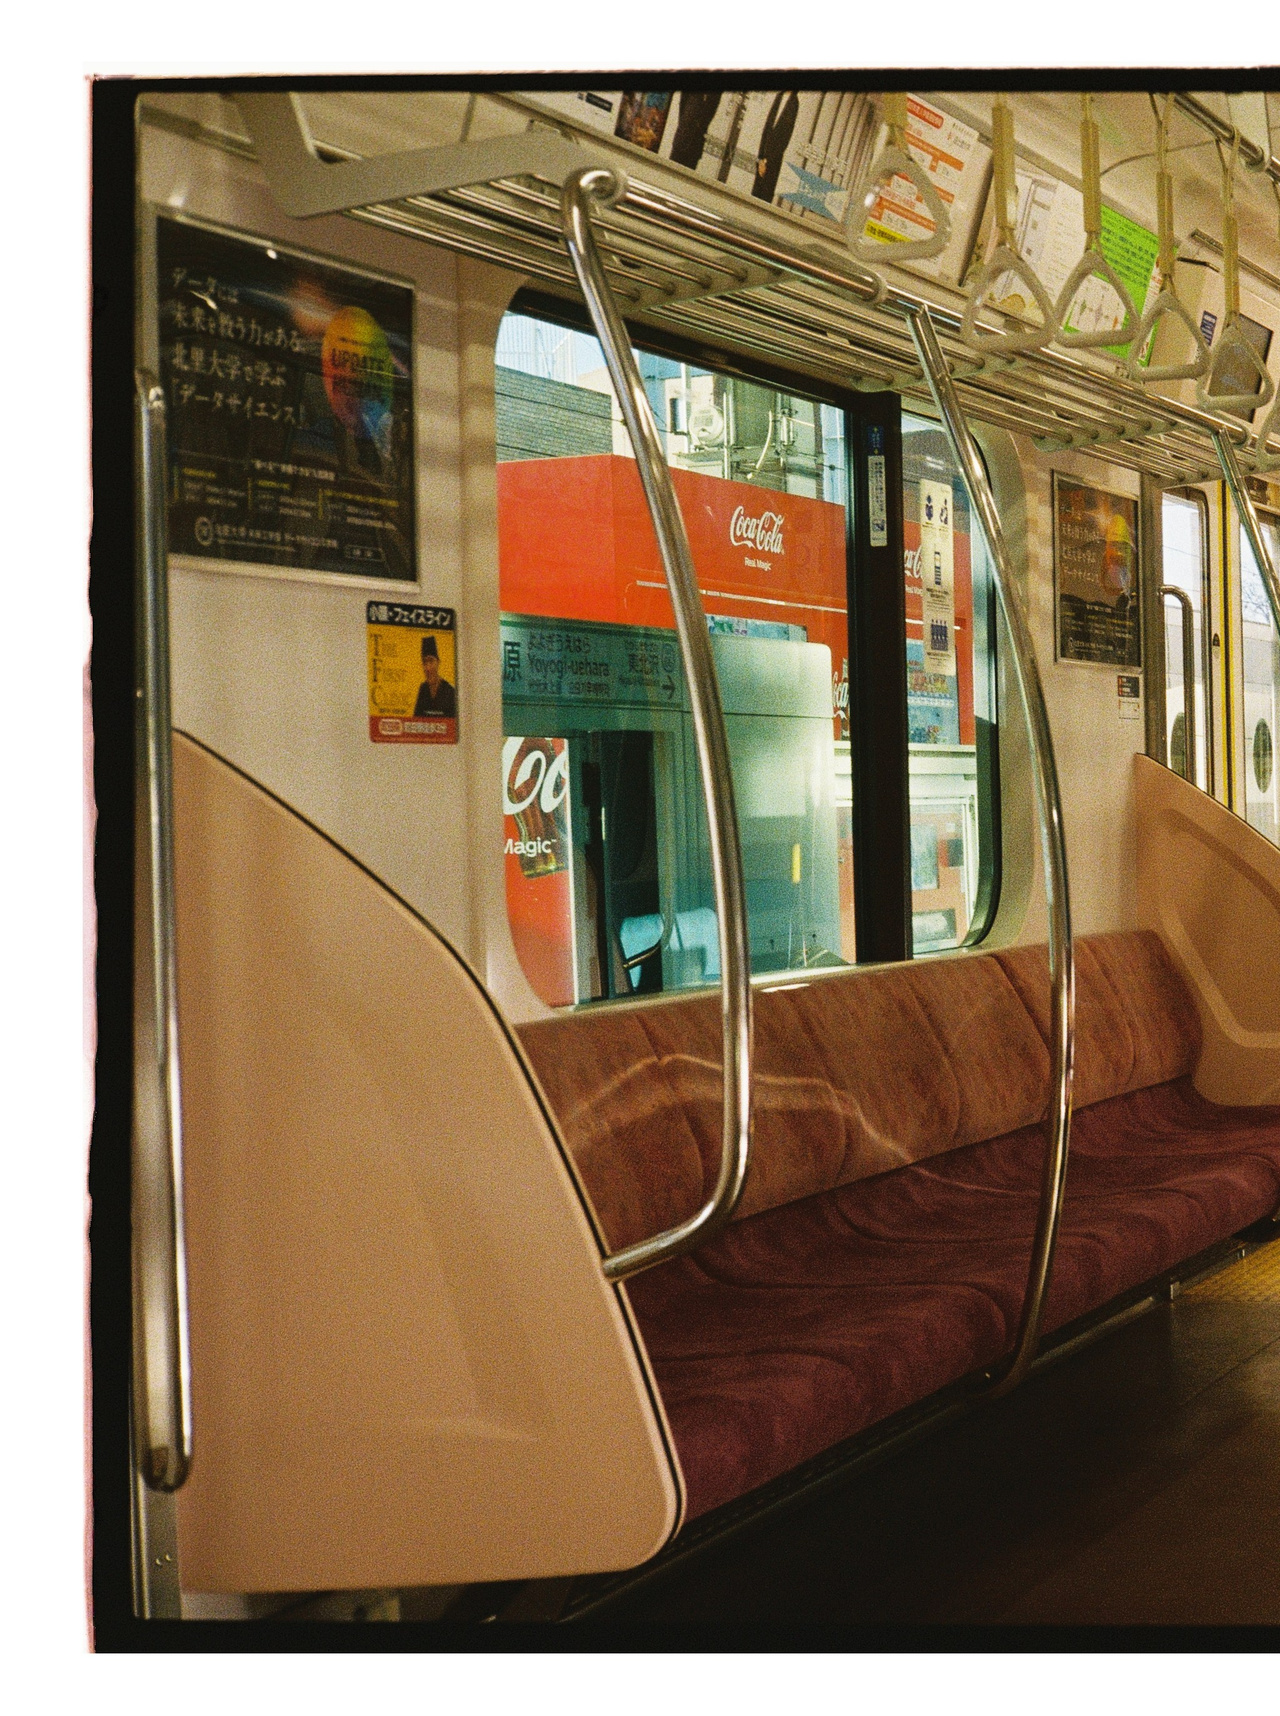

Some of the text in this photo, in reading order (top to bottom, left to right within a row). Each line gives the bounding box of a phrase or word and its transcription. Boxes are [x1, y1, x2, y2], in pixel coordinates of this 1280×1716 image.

[730, 506, 785, 555] Coca-Cola
[744, 556, 772, 572] Real Magic
[504, 640, 521, 682] 原
